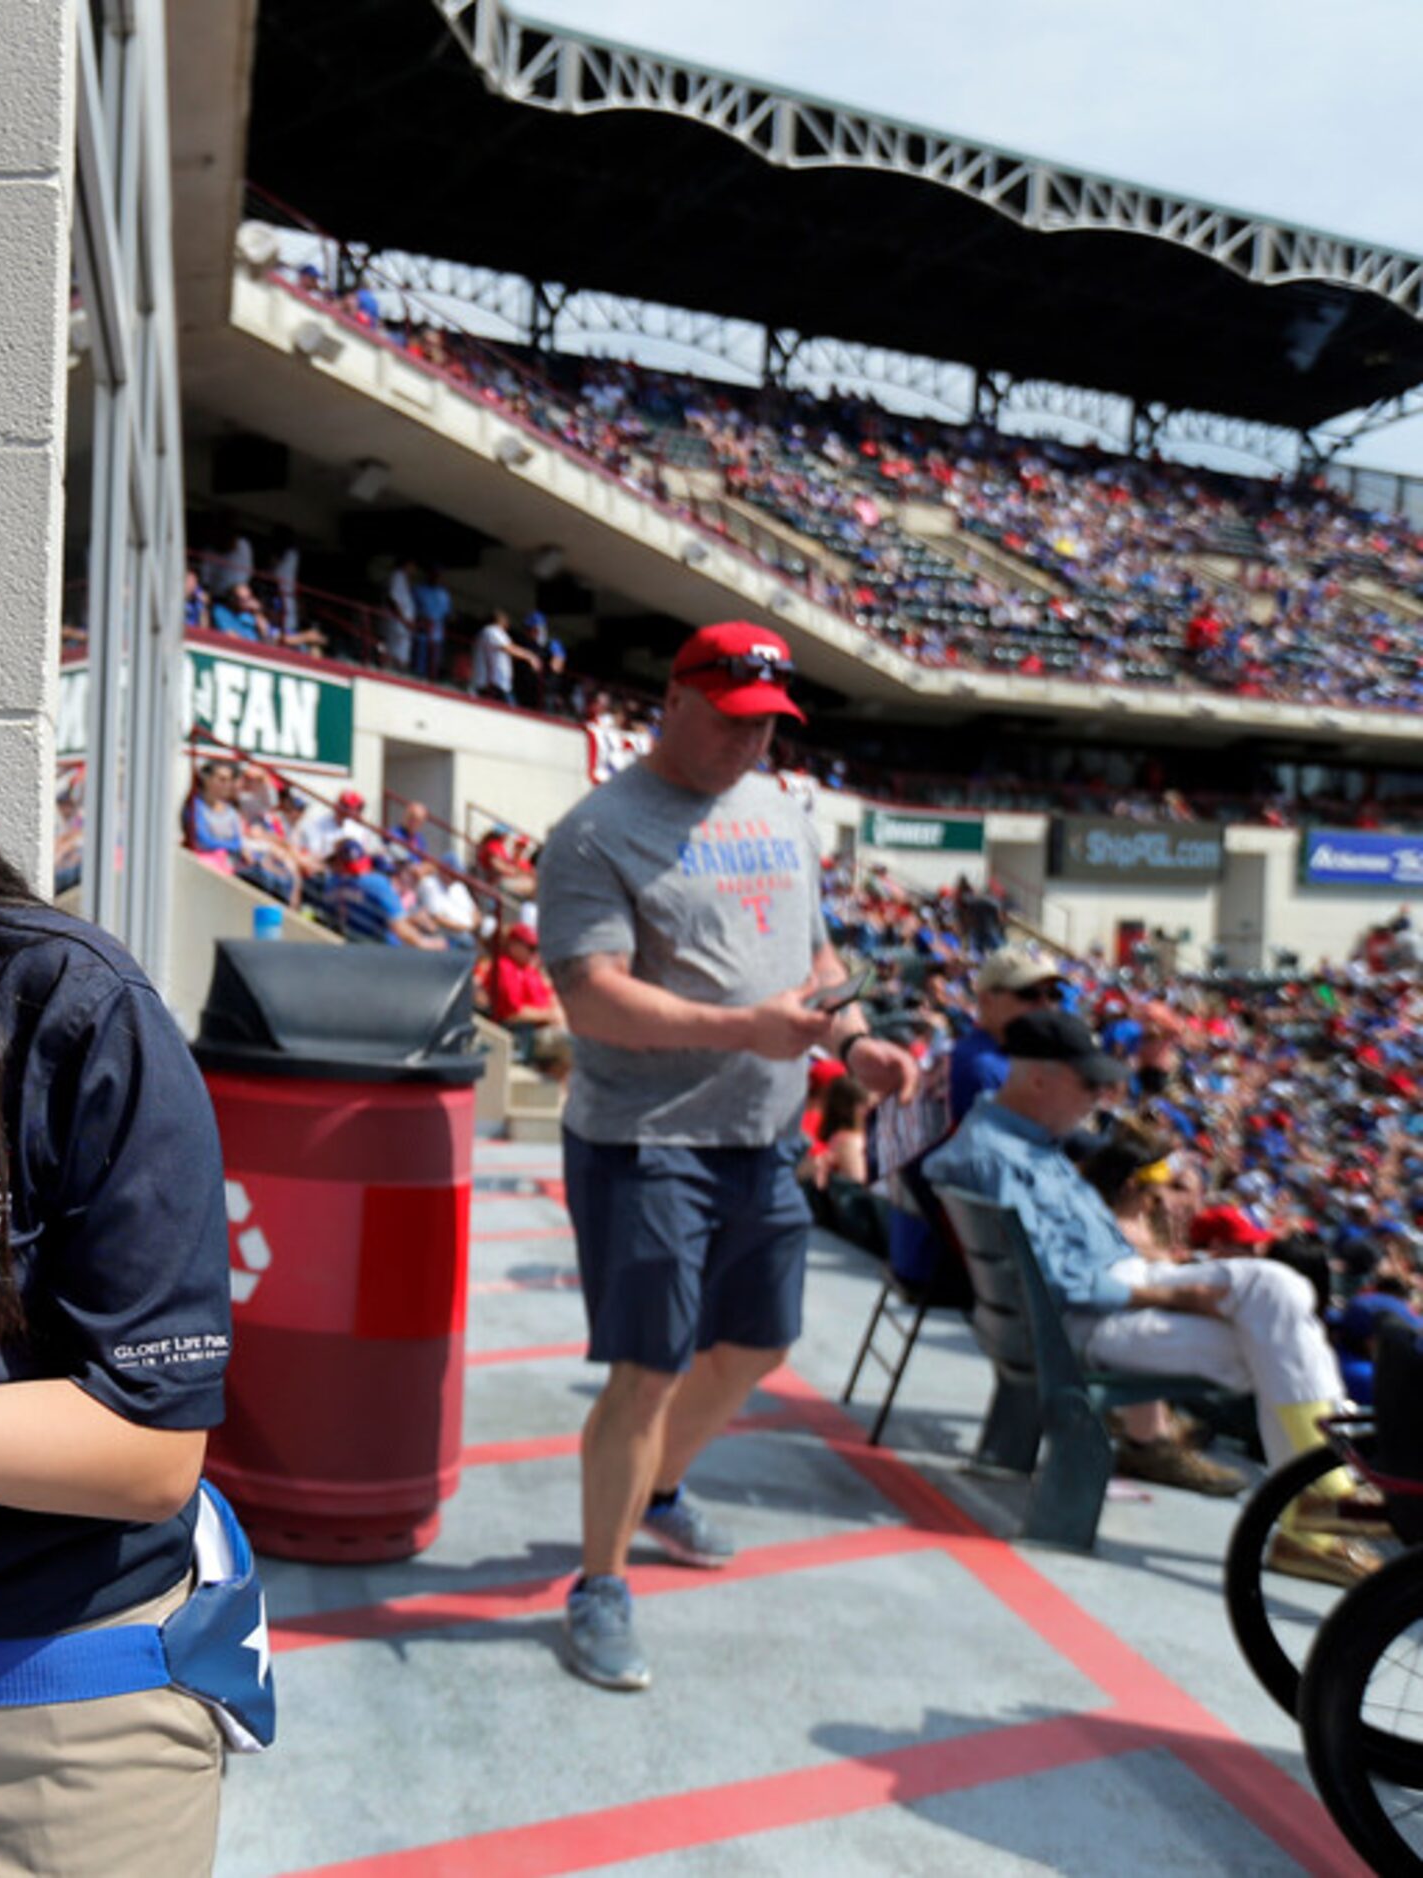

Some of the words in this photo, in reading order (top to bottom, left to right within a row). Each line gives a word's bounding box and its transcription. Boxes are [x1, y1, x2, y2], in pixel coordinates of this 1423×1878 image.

[212, 660, 320, 759] FAN
[675, 838, 800, 877] RANGERS
[114, 1339, 171, 1359] GLOBE
